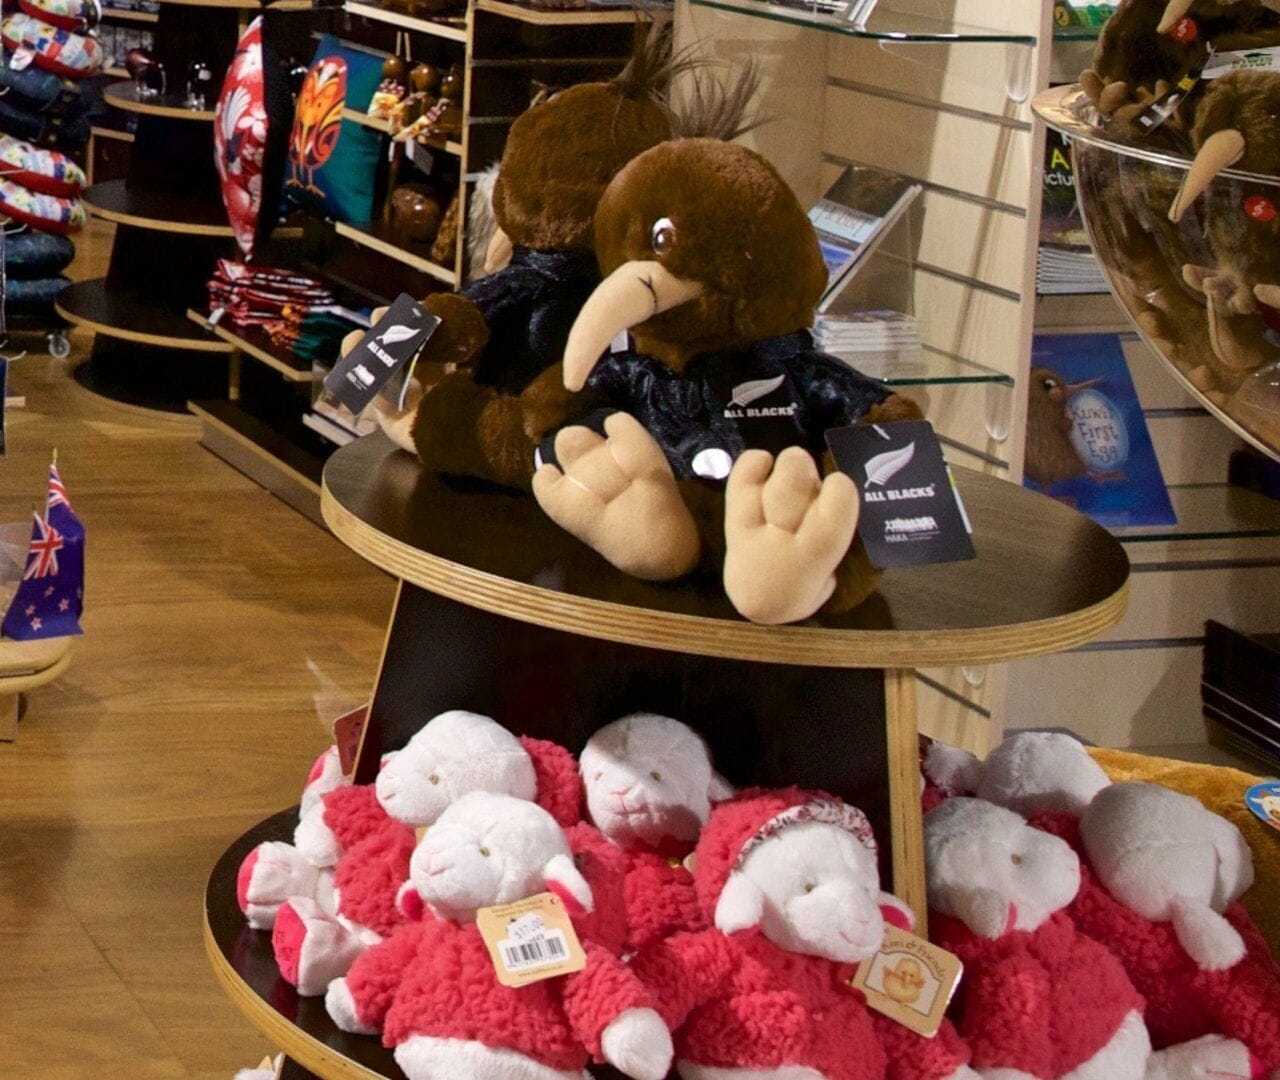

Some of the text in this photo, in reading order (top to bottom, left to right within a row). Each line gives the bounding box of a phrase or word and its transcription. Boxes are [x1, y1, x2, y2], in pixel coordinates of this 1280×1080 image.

[1051, 148, 1070, 169] A
[724, 406, 795, 419] ALL BLACKS
[1077, 422, 1119, 442] First
[1087, 440, 1117, 464] Egg
[864, 487, 936, 503] ALL BLACKS
